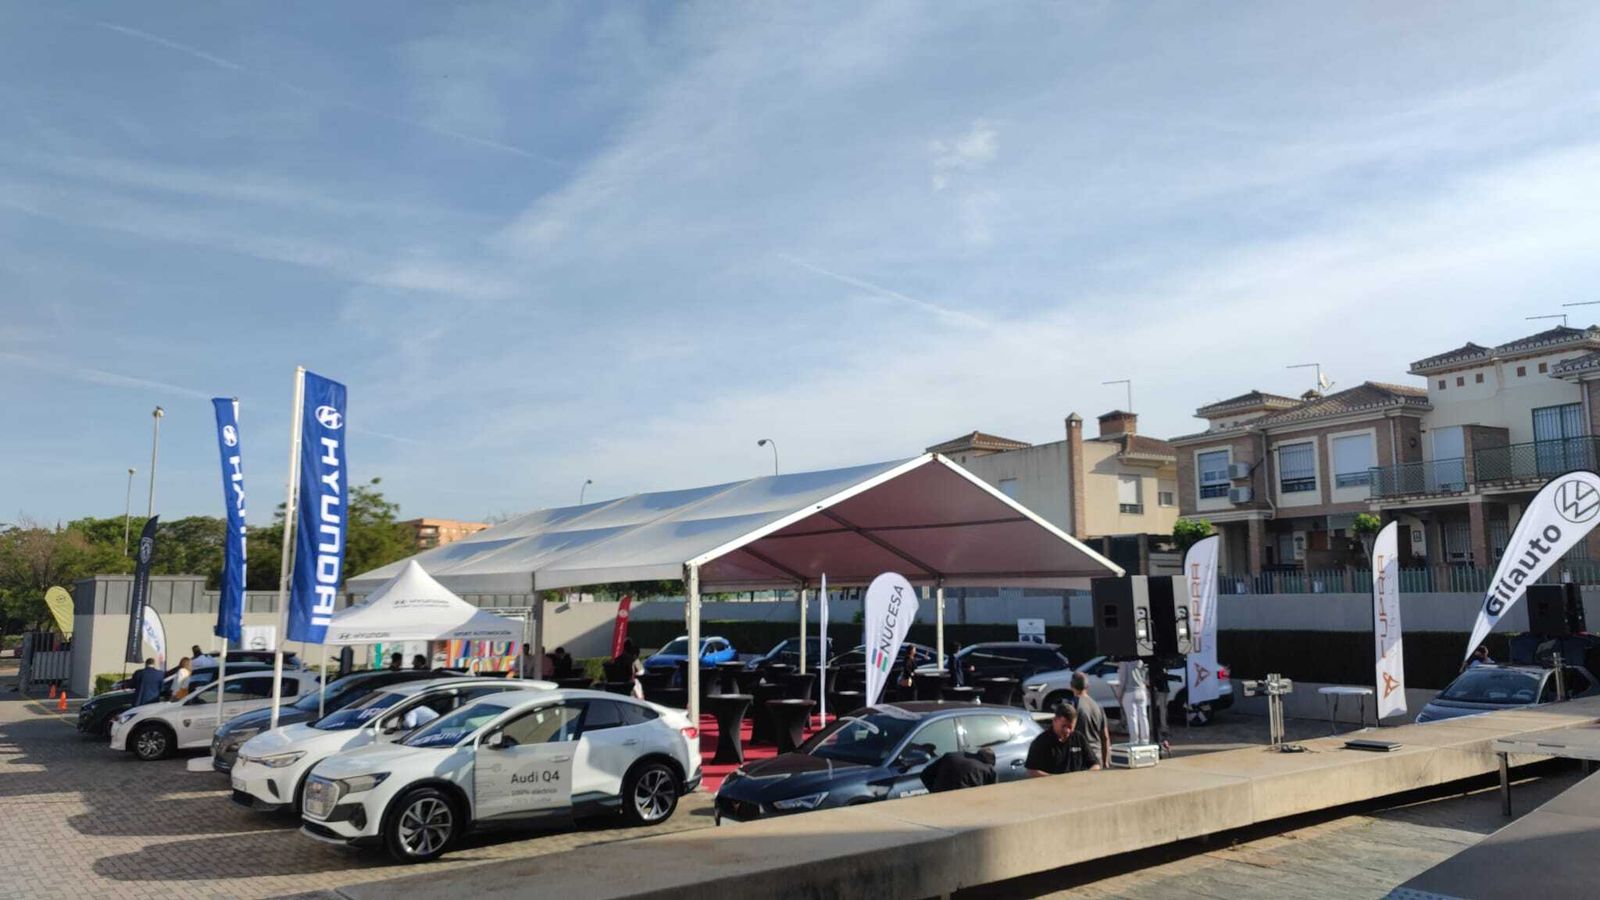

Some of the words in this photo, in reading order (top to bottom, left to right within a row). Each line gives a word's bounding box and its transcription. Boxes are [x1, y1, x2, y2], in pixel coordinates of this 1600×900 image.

[311, 437, 341, 626] HYUNDAI
[1486, 523, 1562, 617] Gilauto
[879, 585, 904, 655] NUCESA
[1192, 563, 1202, 654] CUPRA
[511, 771, 538, 784] Audi
[543, 770, 560, 783] Q4
